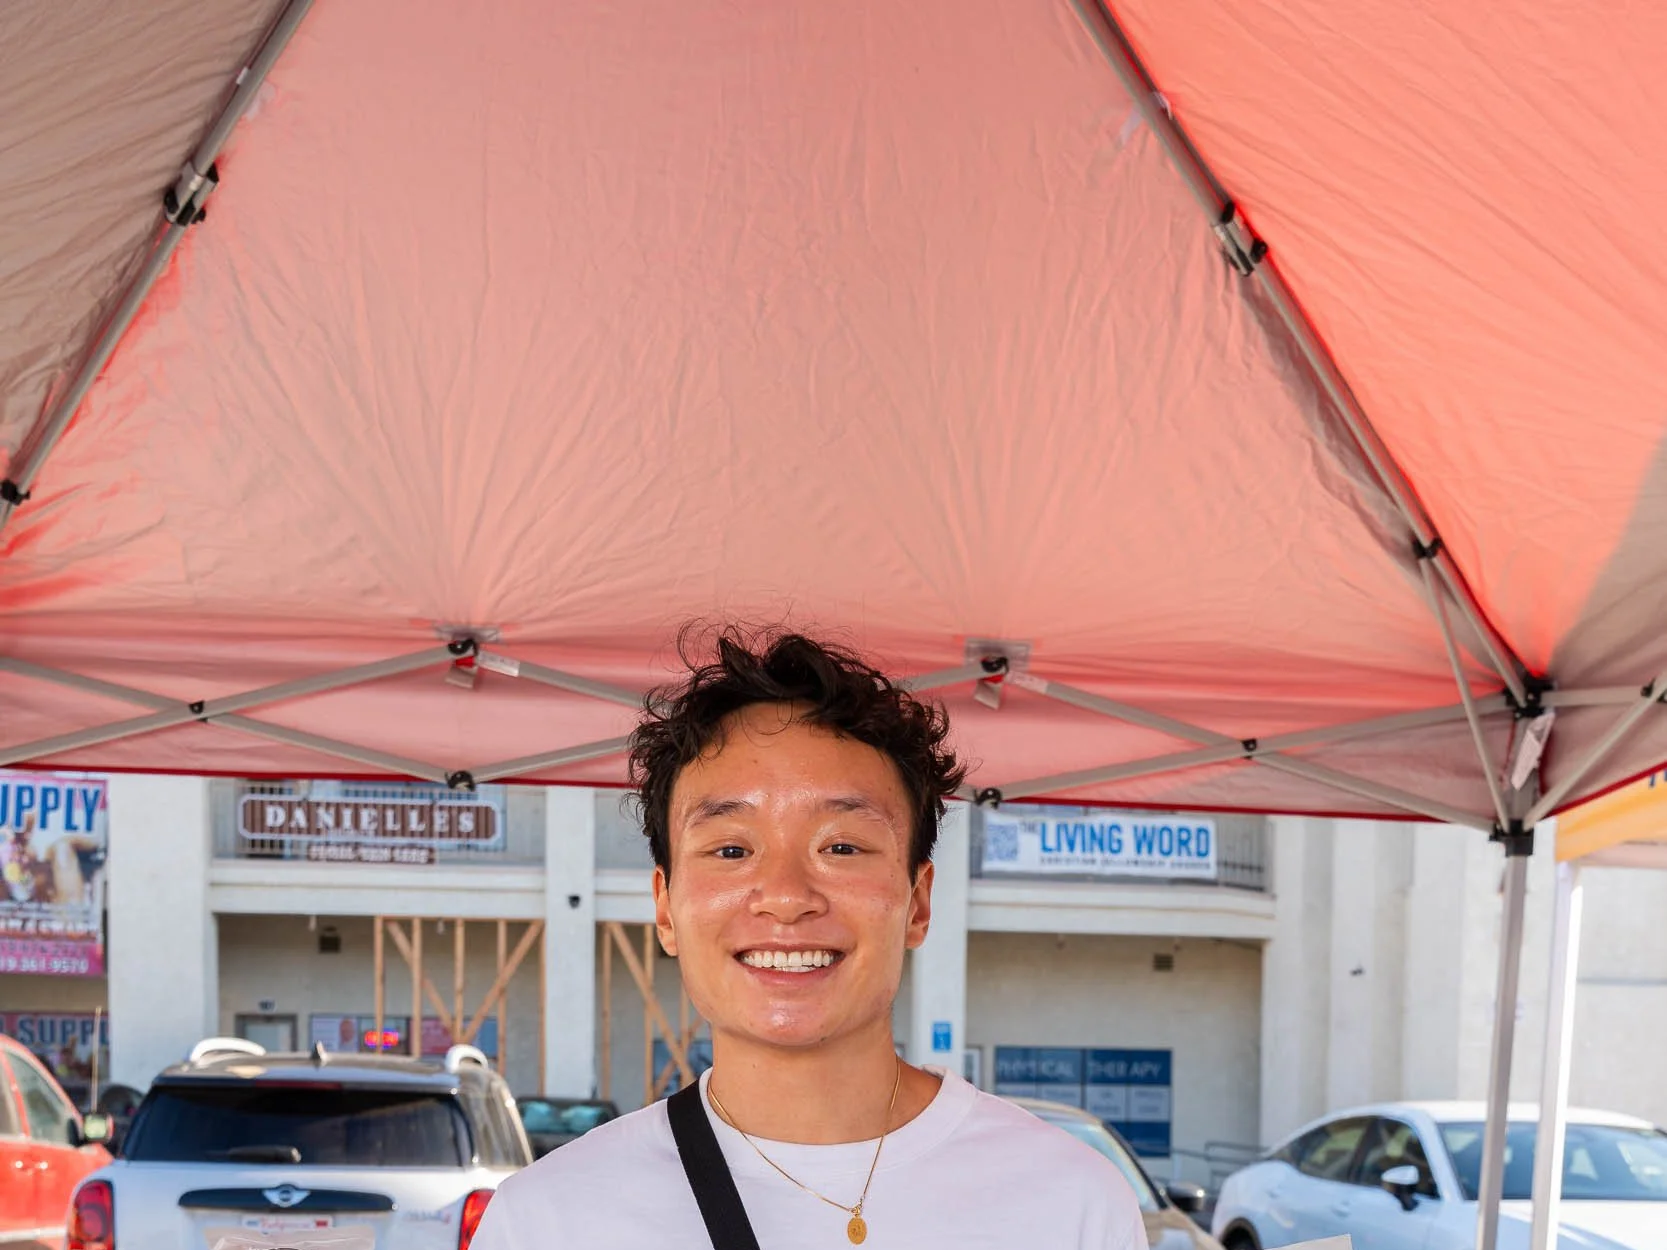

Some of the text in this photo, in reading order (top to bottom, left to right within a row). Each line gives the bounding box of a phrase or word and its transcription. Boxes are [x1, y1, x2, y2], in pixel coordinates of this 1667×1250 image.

[265, 805, 475, 833] DANIELLES
[1040, 822, 1211, 857] LIVING WORD
